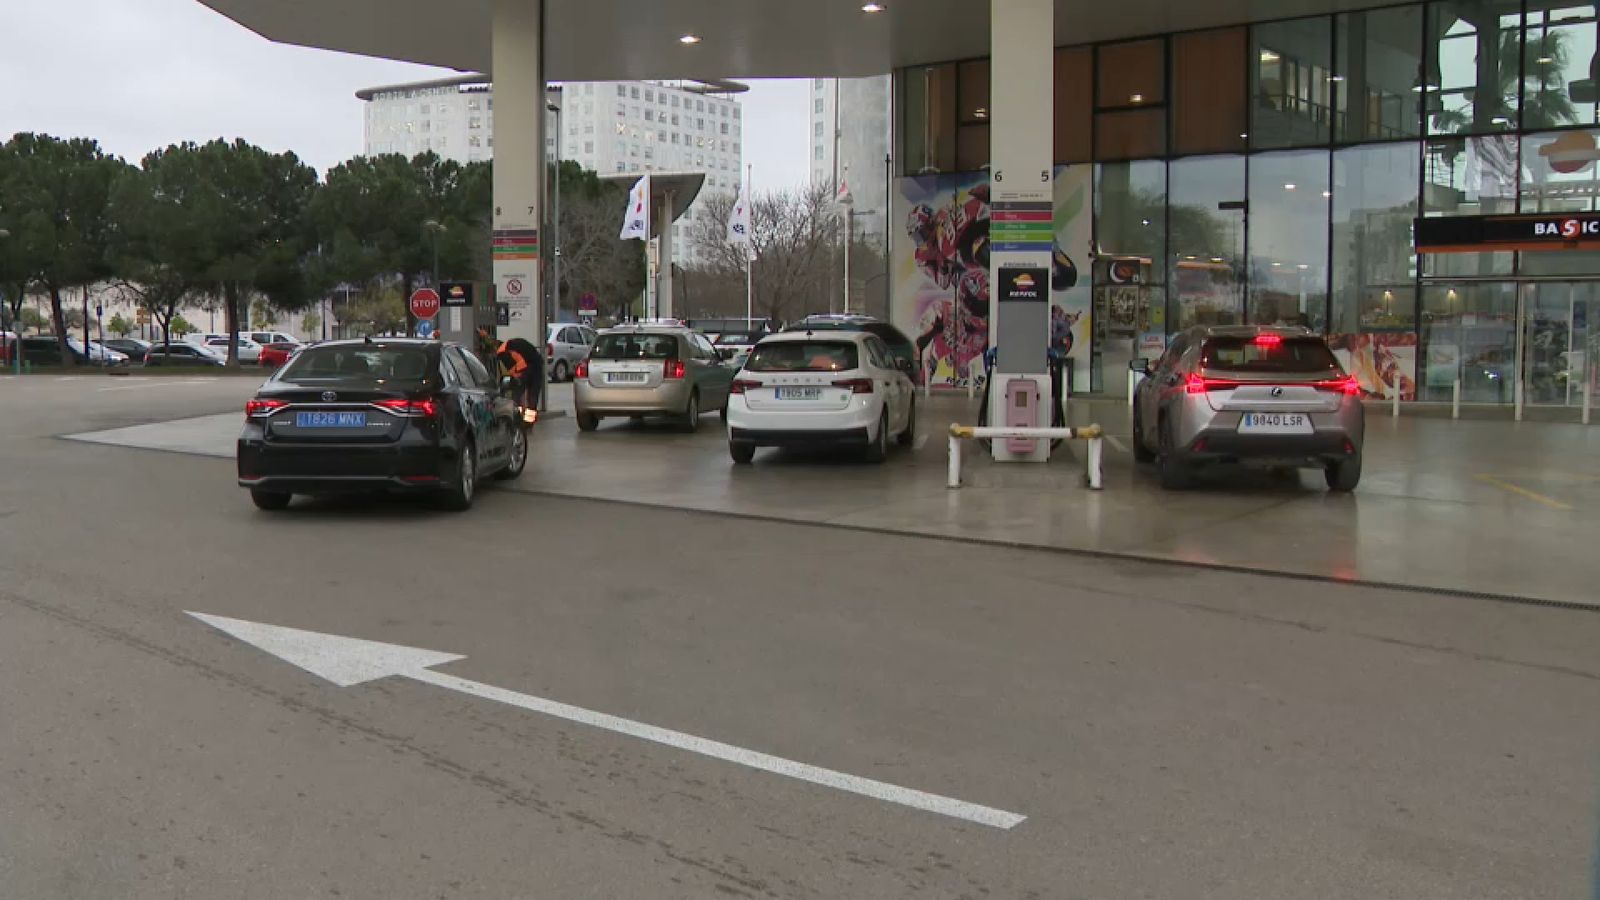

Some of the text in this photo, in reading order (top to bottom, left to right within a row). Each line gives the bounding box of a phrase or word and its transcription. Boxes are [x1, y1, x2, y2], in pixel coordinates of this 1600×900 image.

[995, 171, 1002, 182] 6
[1041, 170, 1049, 182] 5
[528, 206, 534, 215] 7
[1534, 219, 1599, 236] BASIC
[412, 299, 437, 308] STOP
[1253, 415, 1303, 426] 9840 LSR
